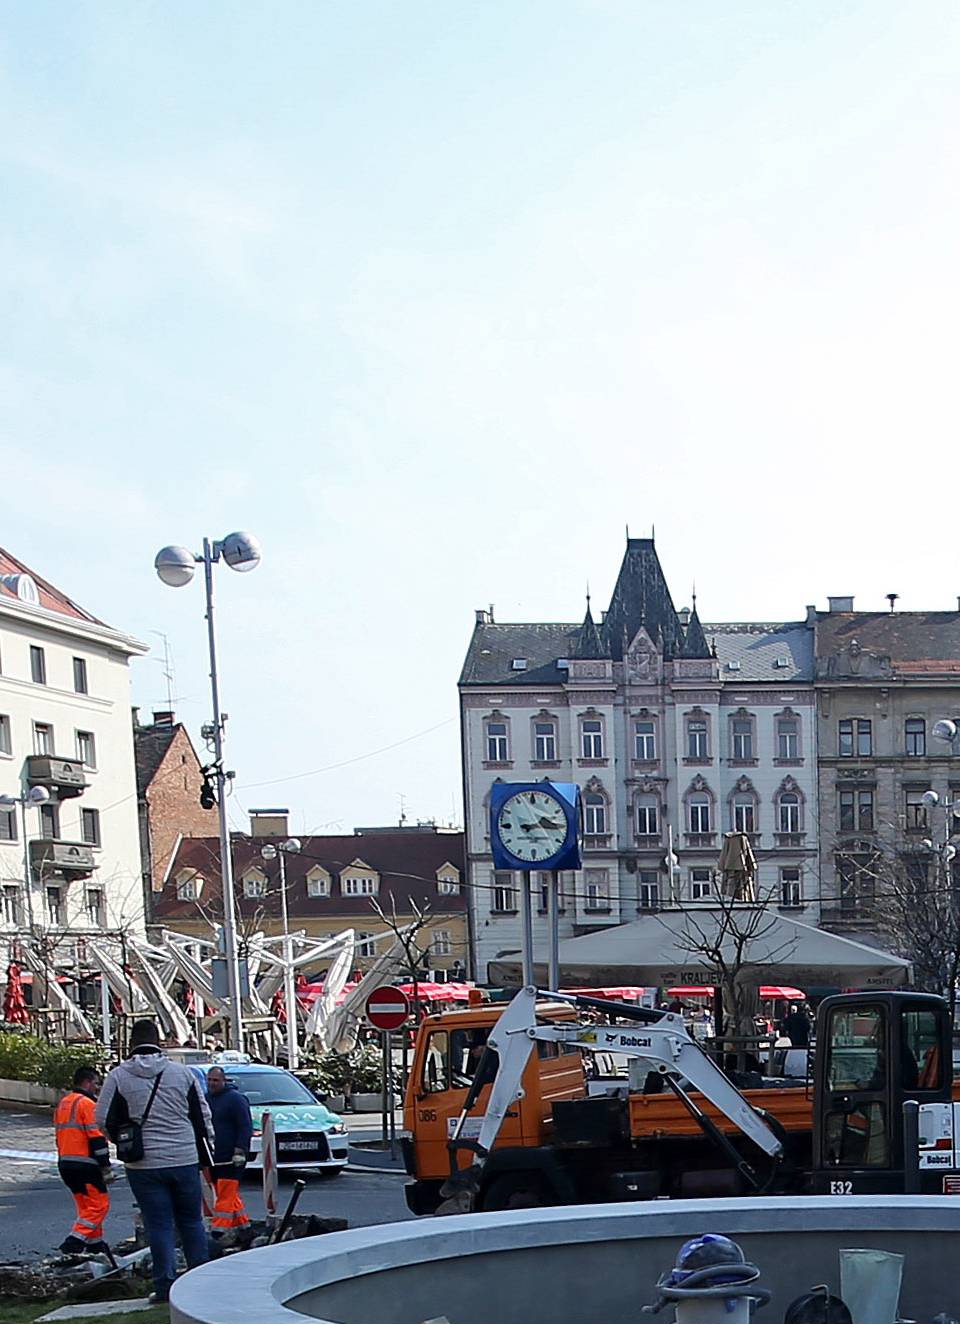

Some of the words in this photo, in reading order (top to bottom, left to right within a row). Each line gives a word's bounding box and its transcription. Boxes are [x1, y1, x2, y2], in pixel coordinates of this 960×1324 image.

[620, 1036, 651, 1047] Bobcat
[926, 1155, 951, 1164] Bobcat
[830, 1181, 853, 1195] E32
